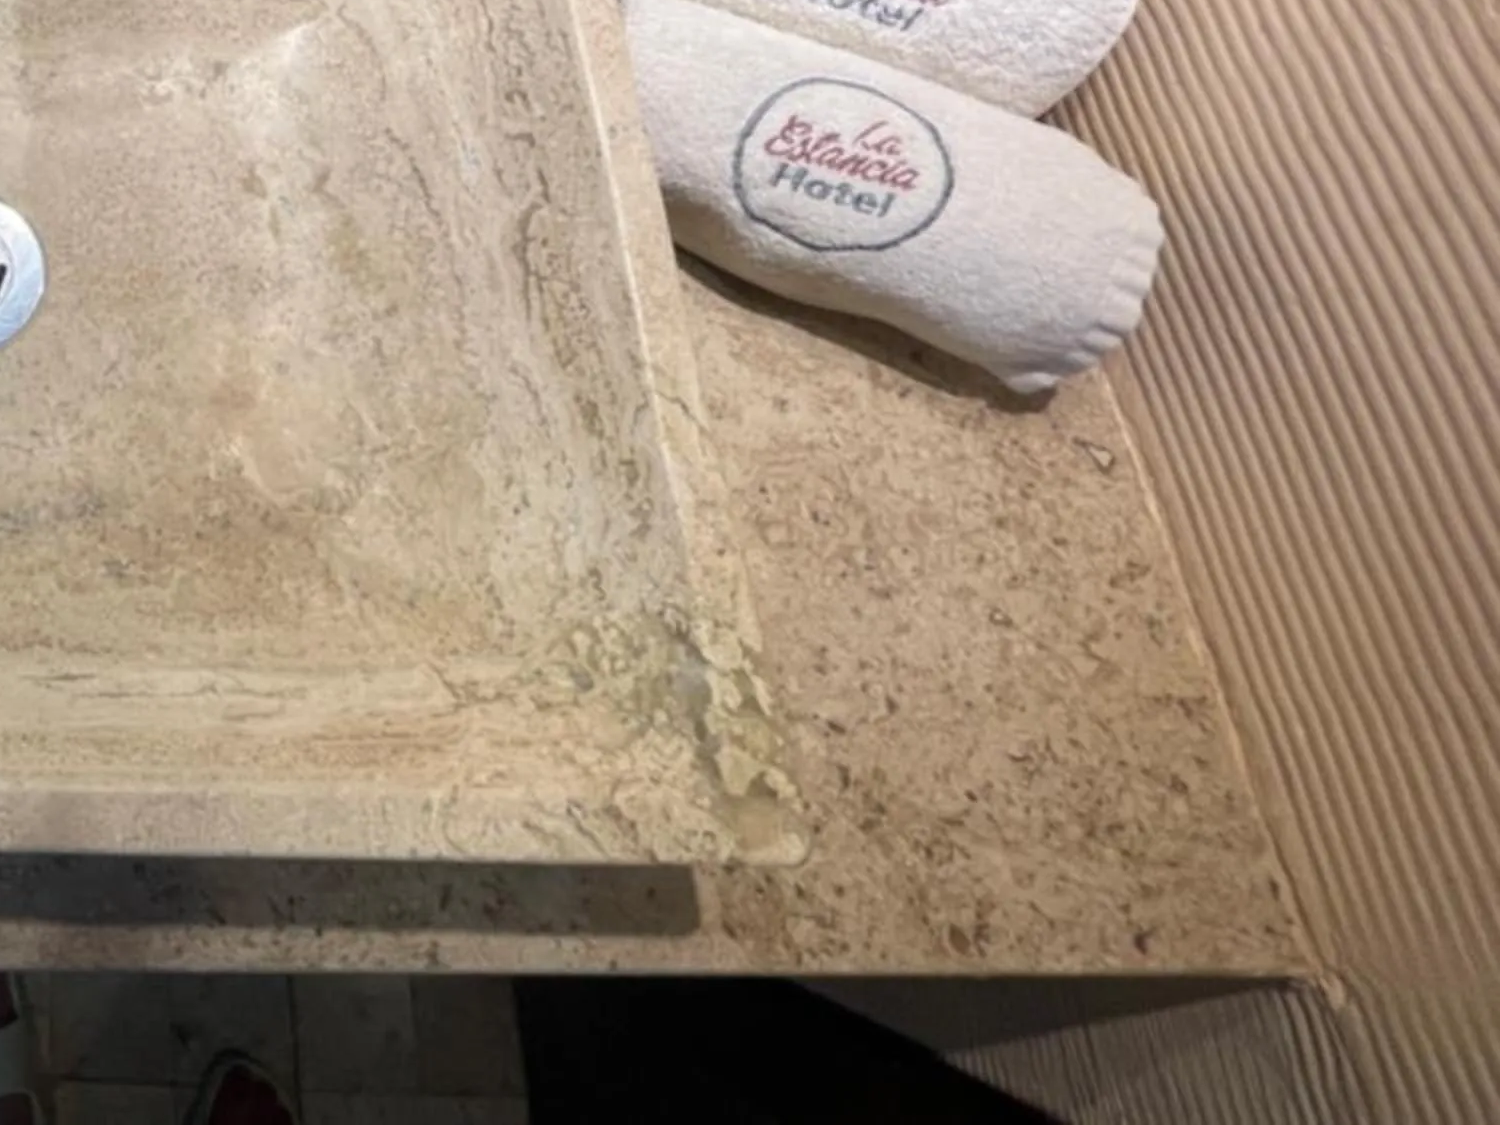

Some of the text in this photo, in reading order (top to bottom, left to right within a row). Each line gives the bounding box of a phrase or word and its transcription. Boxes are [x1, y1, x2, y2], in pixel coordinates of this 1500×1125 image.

[764, 114, 921, 191] Estancia
[852, 120, 903, 156] La
[770, 161, 897, 218] Hotel
